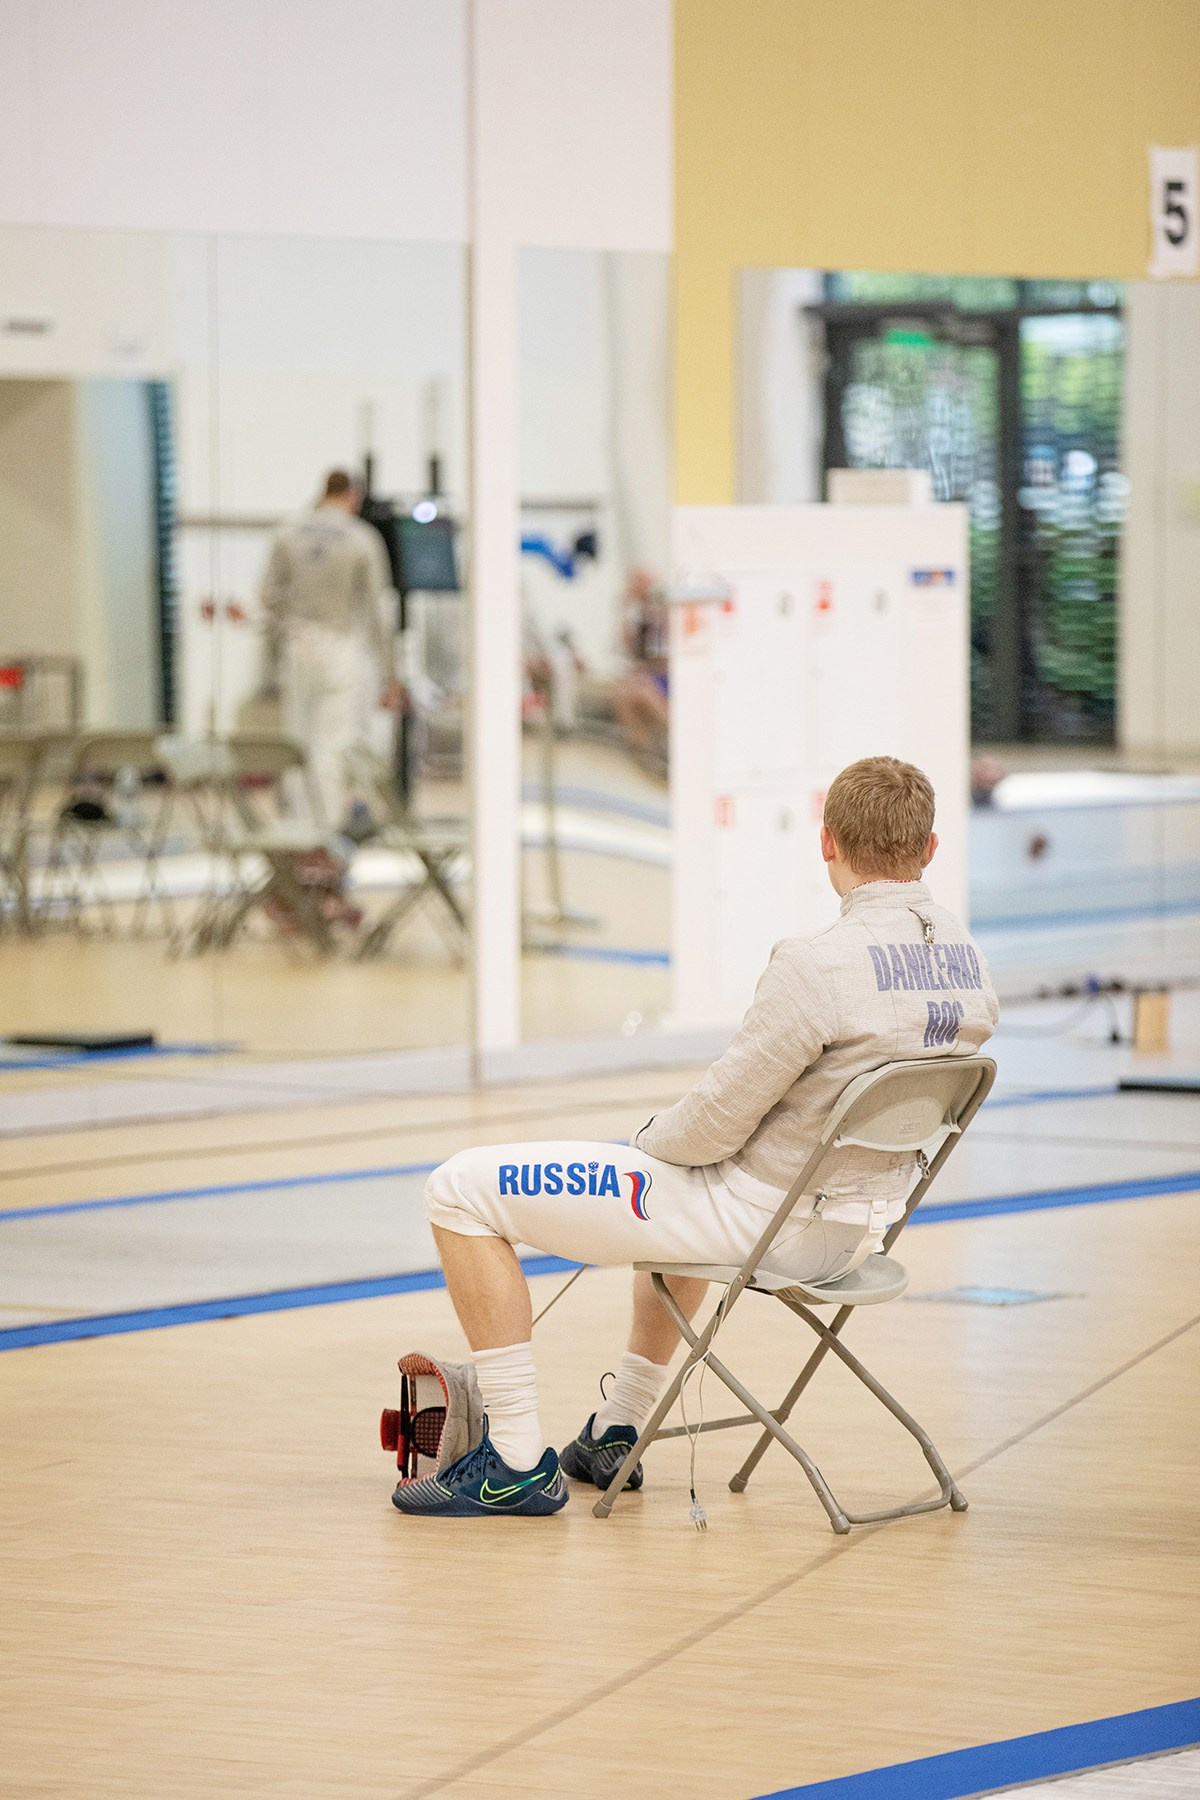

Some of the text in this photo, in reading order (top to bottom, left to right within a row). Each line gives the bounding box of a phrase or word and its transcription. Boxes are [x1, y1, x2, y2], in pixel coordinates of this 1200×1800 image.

[1163, 180, 1189, 247] 5
[867, 943, 983, 992] DANILENKO
[923, 1001, 965, 1048] ROC
[499, 1161, 621, 1197] RUSSIA
